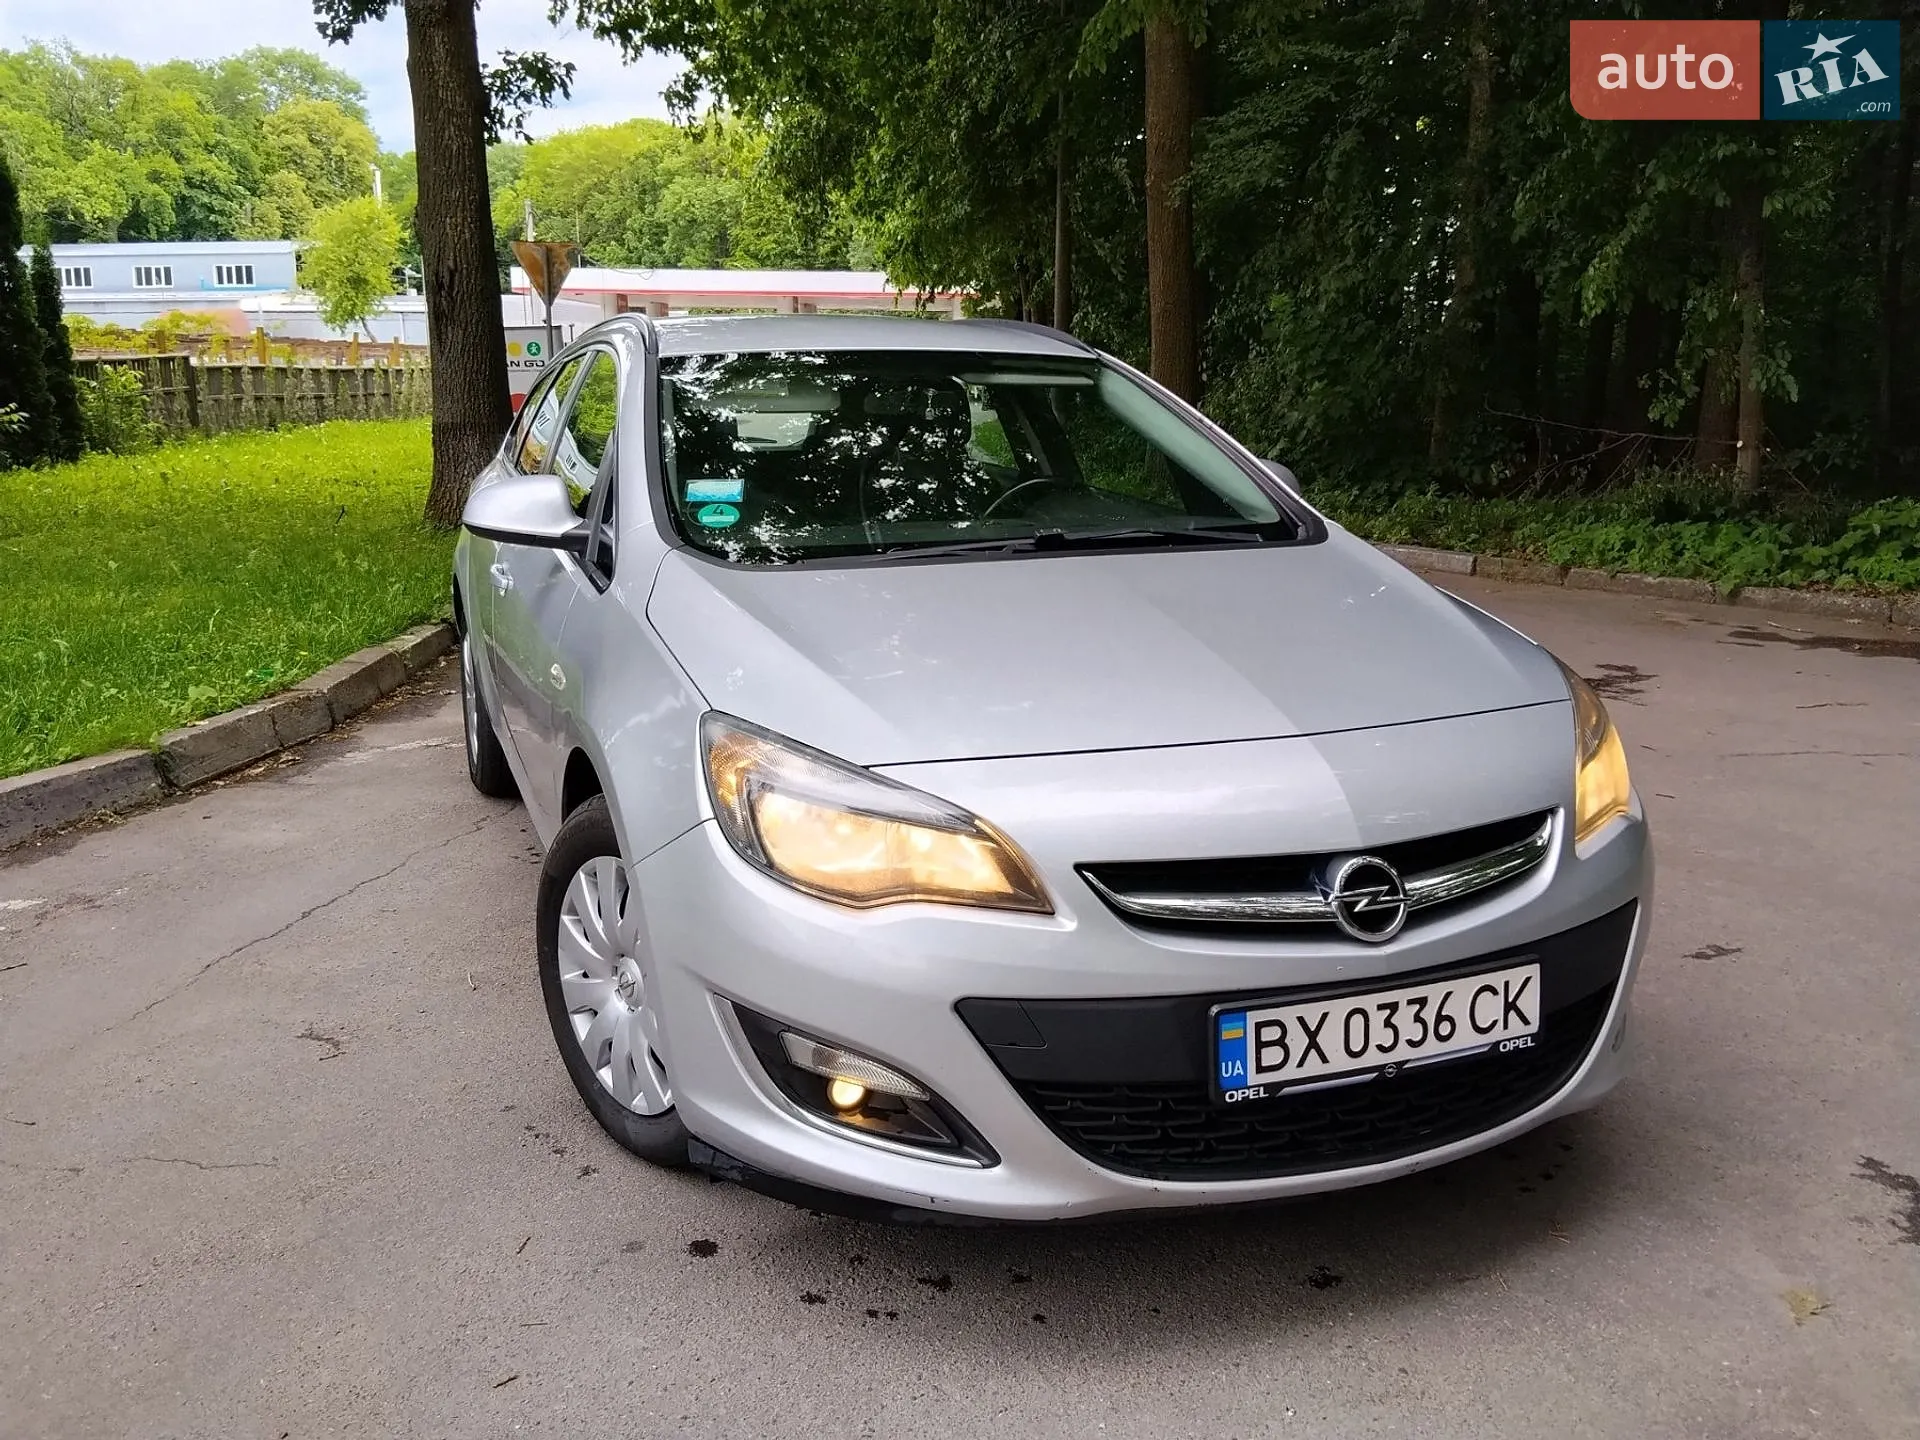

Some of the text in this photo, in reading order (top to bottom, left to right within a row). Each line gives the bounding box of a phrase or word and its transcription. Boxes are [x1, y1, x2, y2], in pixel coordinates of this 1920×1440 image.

[1253, 975, 1534, 1075] BX 0336 CK
[1499, 1036, 1536, 1052] OPEL
[1221, 1060, 1244, 1078] UA
[1224, 1086, 1270, 1103] OPEL
